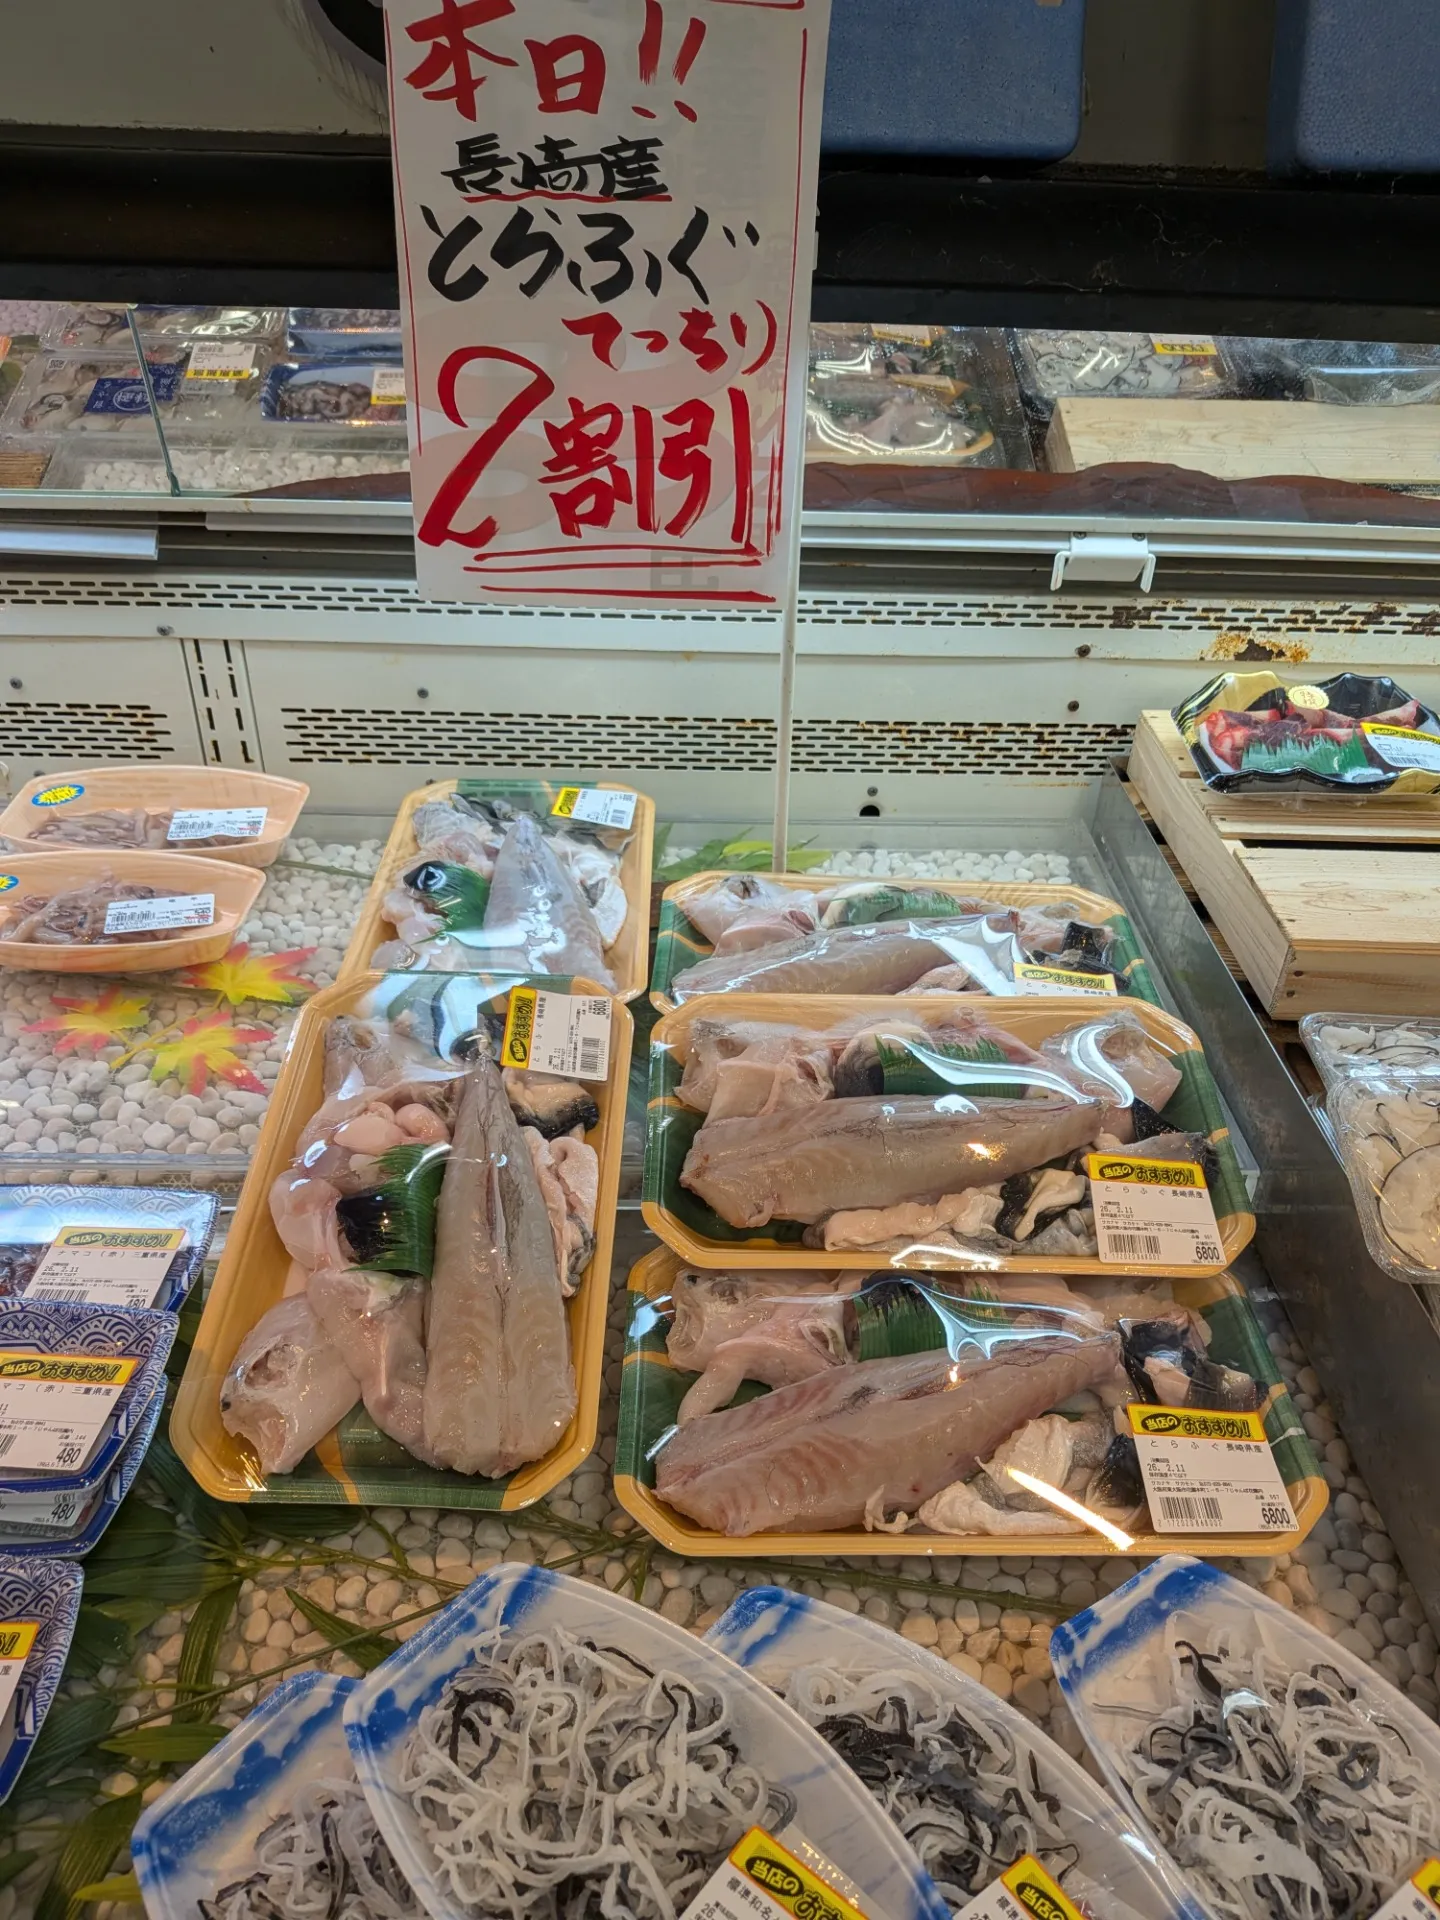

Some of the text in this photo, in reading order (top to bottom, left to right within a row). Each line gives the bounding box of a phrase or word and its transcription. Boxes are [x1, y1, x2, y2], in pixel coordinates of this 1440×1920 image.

[440, 133, 670, 199] 長崎産
[420, 203, 760, 304] とらふぐ
[561, 300, 777, 375] てっちり
[417, 346, 753, 547] 2割引
[593, 1000, 607, 1015] 6800
[1195, 1246, 1220, 1260] 6800
[72, 1386, 114, 1396] 三重県産
[1146, 1416, 1251, 1437] 当店のおすすめ!
[1150, 1440, 1263, 1453] とらふぐ 長崎県産
[56, 1448, 81, 1464] 480
[51, 1503, 76, 1520] 480
[1262, 1508, 1290, 1524] 6800
